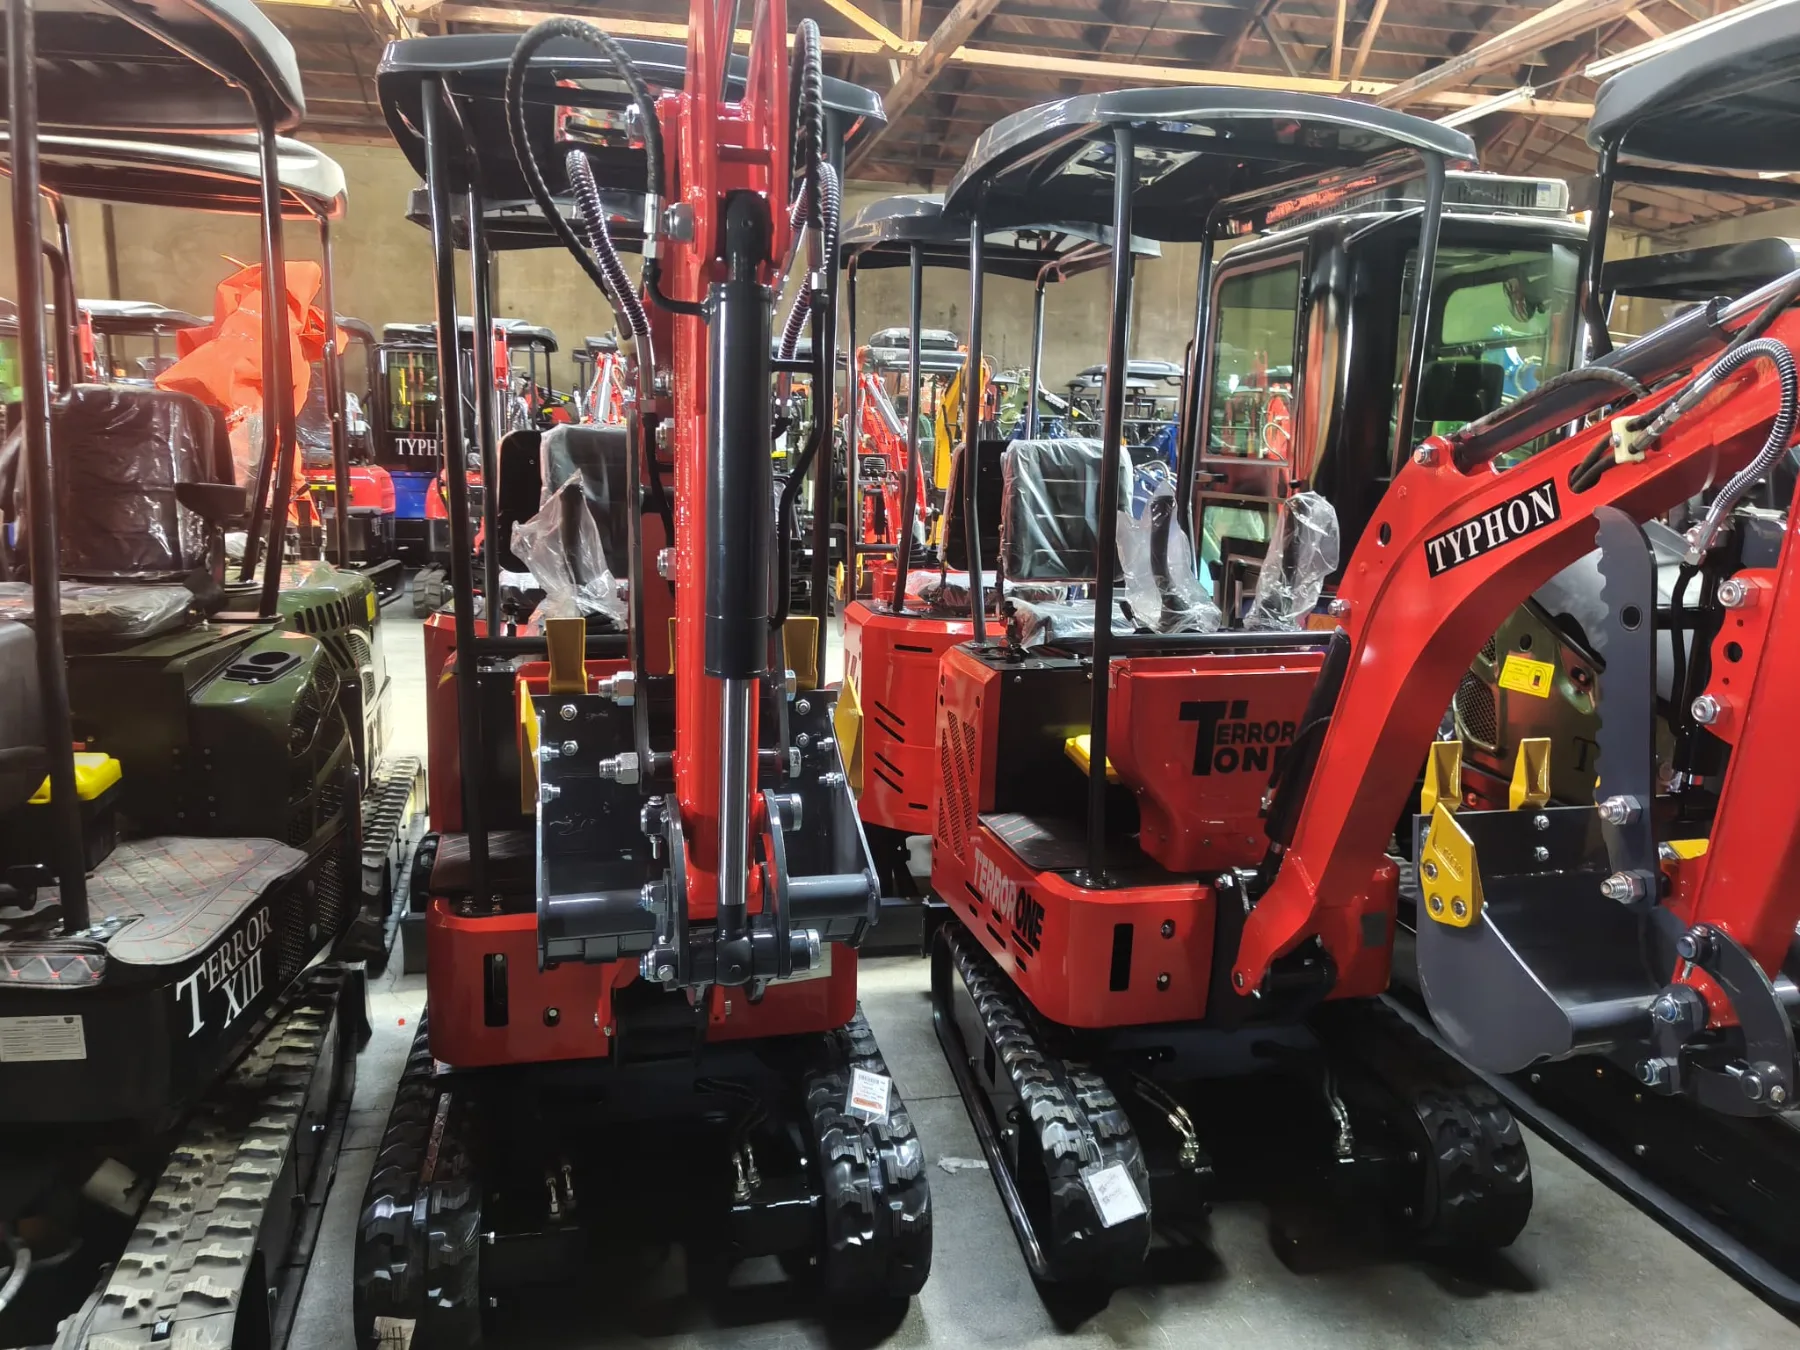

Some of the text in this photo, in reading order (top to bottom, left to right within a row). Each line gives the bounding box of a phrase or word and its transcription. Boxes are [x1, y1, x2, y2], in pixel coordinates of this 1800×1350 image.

[395, 438, 447, 456] TYPH
[1428, 484, 1555, 572] TYPHON
[1179, 700, 1296, 776] TERROR
[974, 847, 1045, 952] TERROR ONE
[176, 906, 273, 1038] TERROR
[221, 948, 264, 1029] XIII
